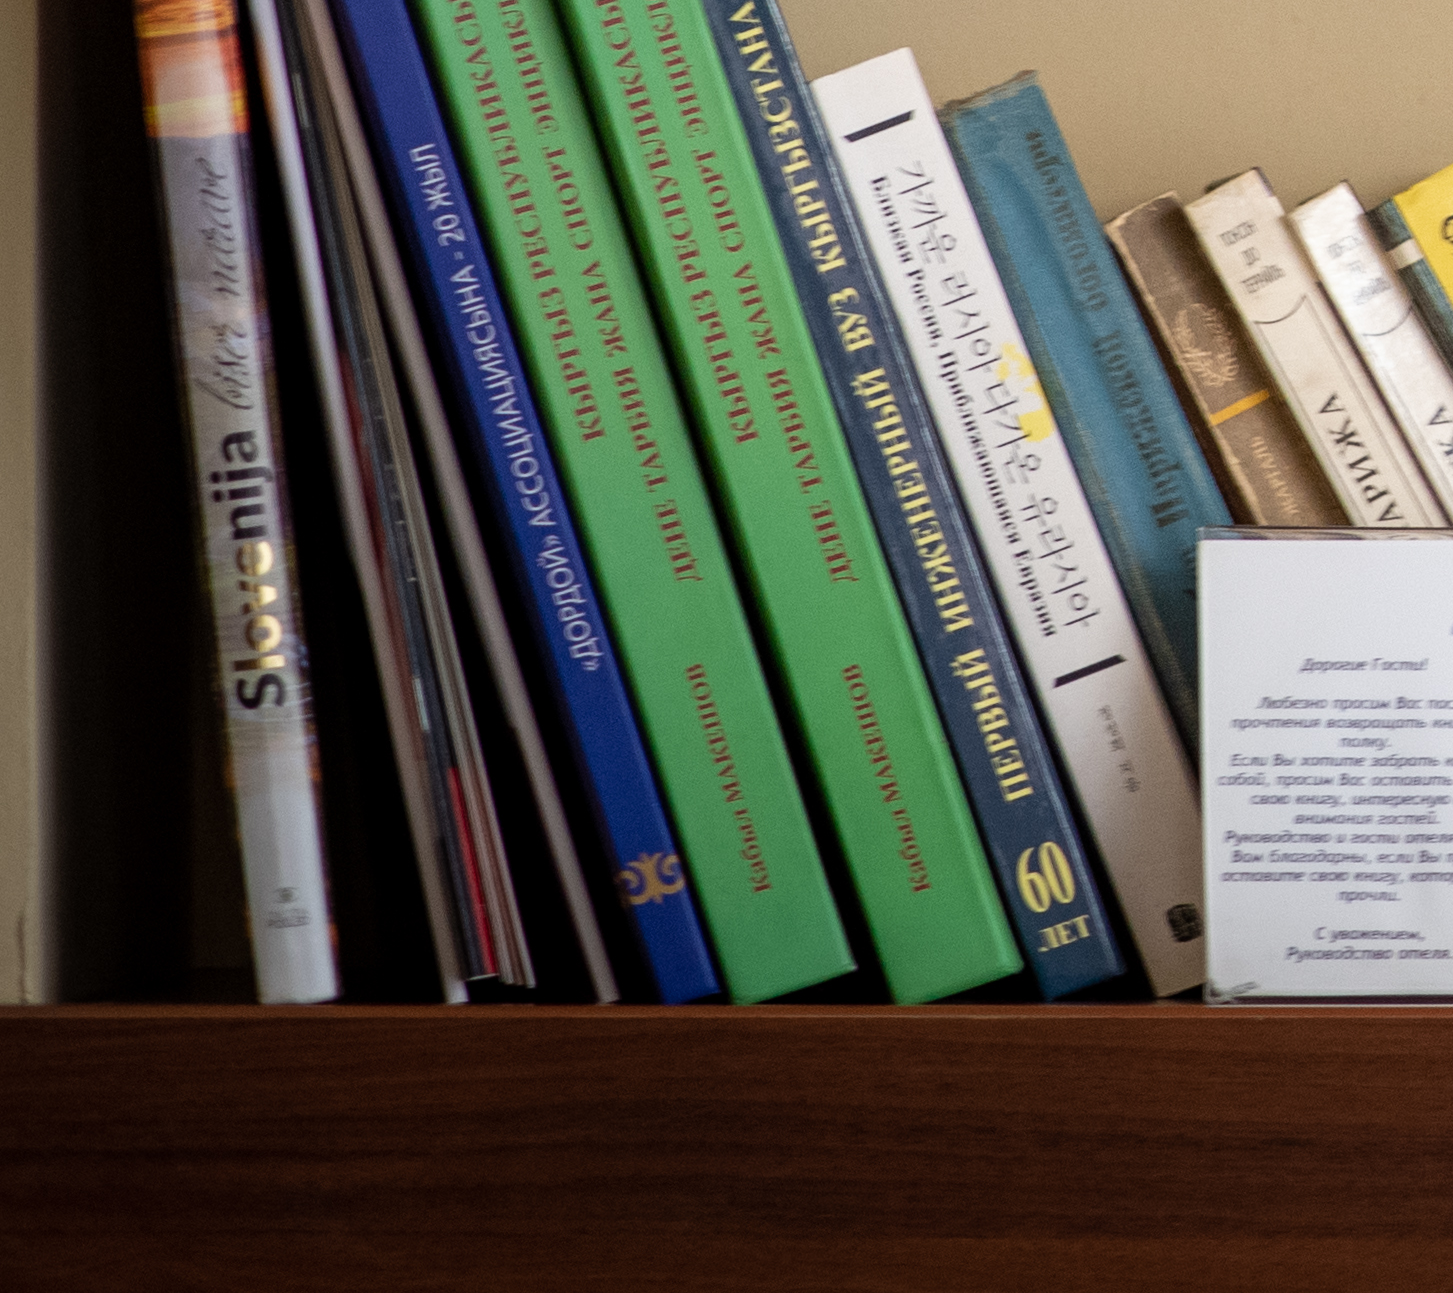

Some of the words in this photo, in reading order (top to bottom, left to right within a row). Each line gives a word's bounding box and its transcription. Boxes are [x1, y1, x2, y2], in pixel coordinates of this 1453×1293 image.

[408, 140, 455, 212] ЖЫЛ
[432, 211, 467, 248] 20
[541, 140, 597, 254] СПОРТ
[578, 258, 629, 359] ЖАНА
[826, 283, 876, 353] ВУЗ
[447, 263, 561, 531] АССОЦИАЦИЯСЫНА
[611, 364, 670, 493] ТАРБИЯ
[889, 156, 963, 267] 가까운
[932, 267, 1005, 379] 러시아
[974, 377, 1047, 488] 다가온
[1015, 485, 1103, 634] 유라시아
[651, 496, 703, 587] ДЕНЕ
[848, 364, 975, 637] ИНЖЕНЕРНЫЙ
[205, 427, 300, 712] Slovenija
[531, 529, 606, 676] «ДОРДОЙ»
[945, 643, 1035, 807] ПЕРВЫЙ
[1006, 836, 1081, 917] 60
